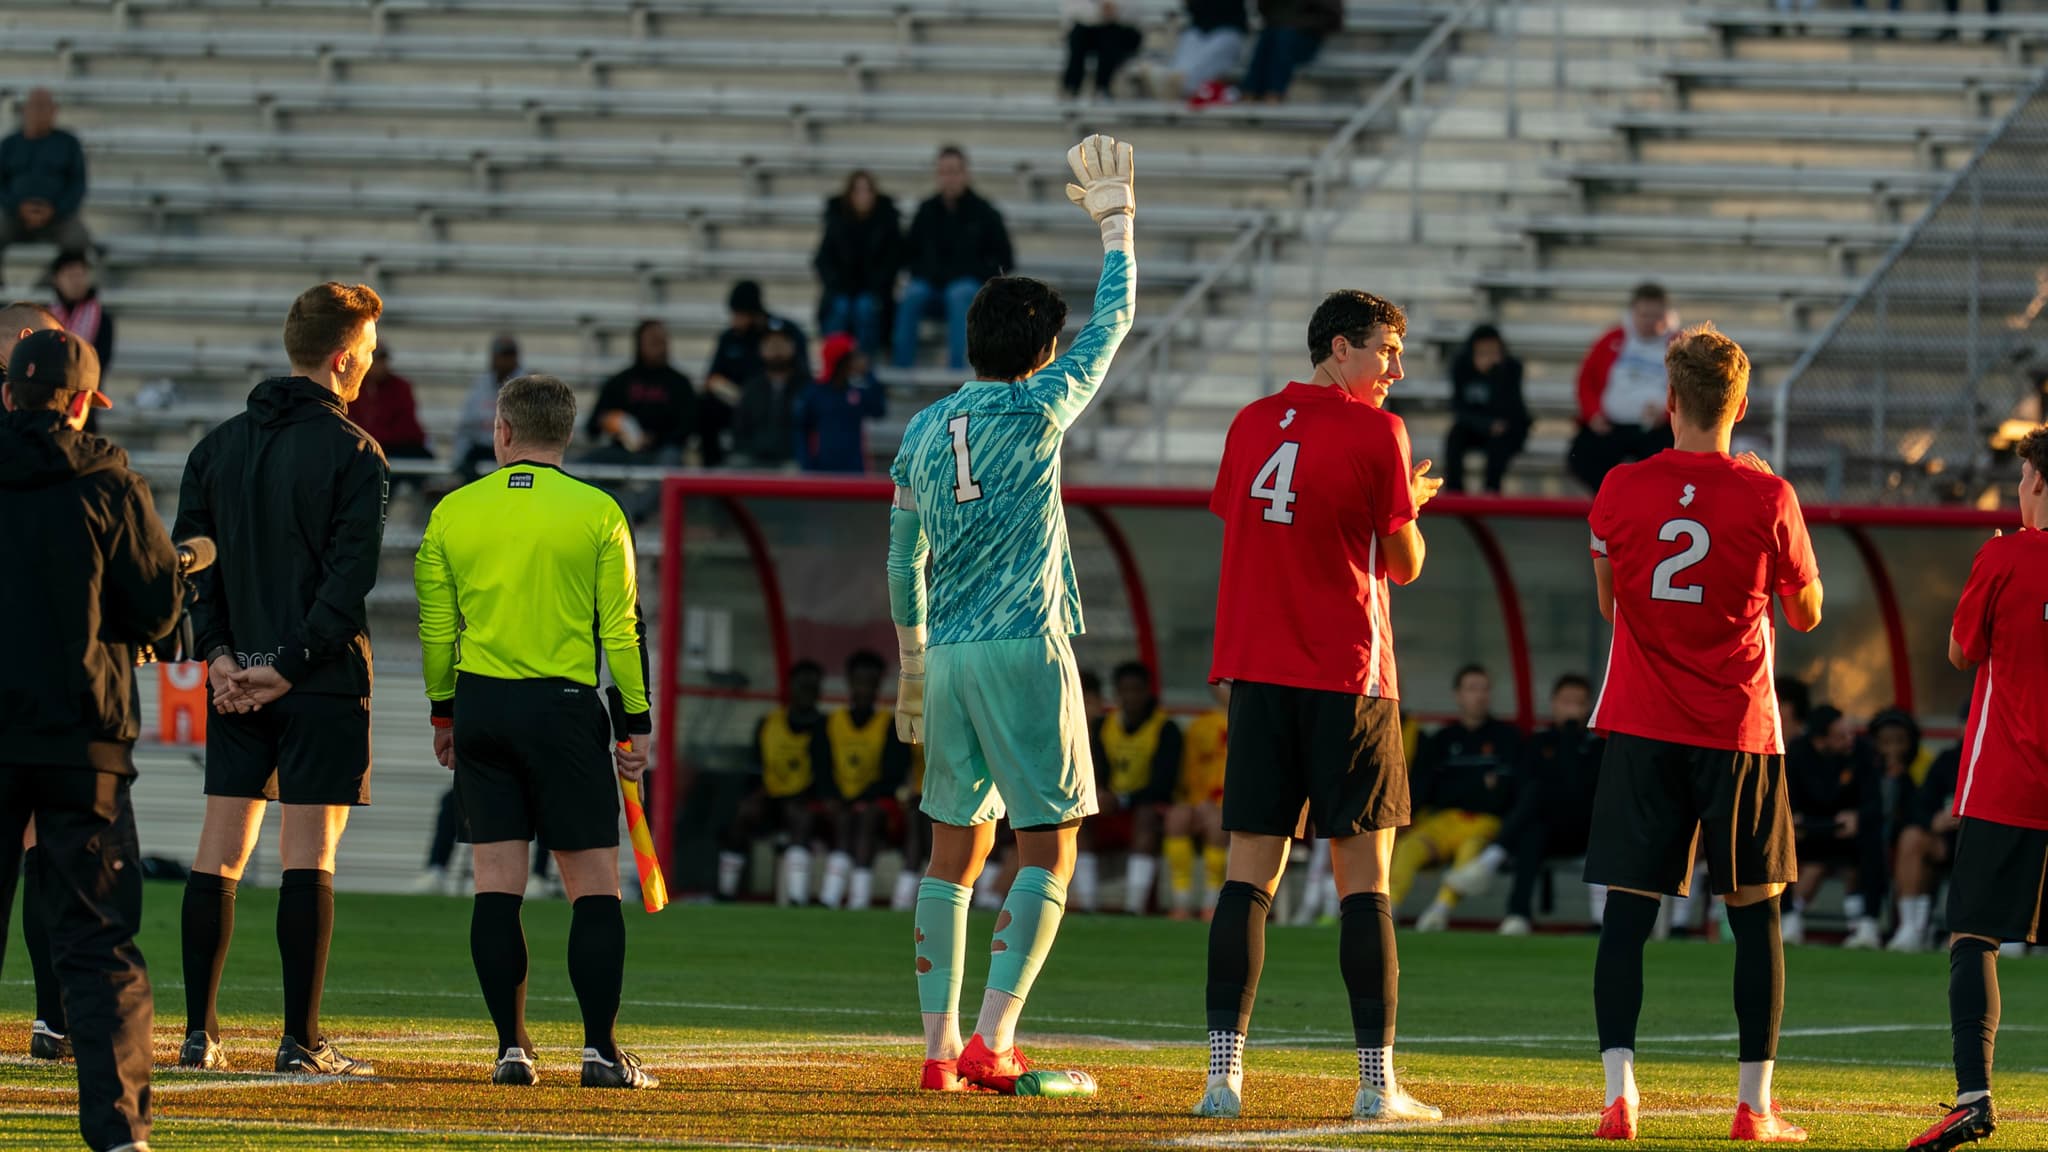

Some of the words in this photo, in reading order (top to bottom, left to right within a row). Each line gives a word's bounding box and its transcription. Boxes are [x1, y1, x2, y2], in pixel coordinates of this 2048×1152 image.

[948, 414, 983, 504] 1
[1250, 441, 1300, 525] 4
[1650, 517, 1711, 604] 2
